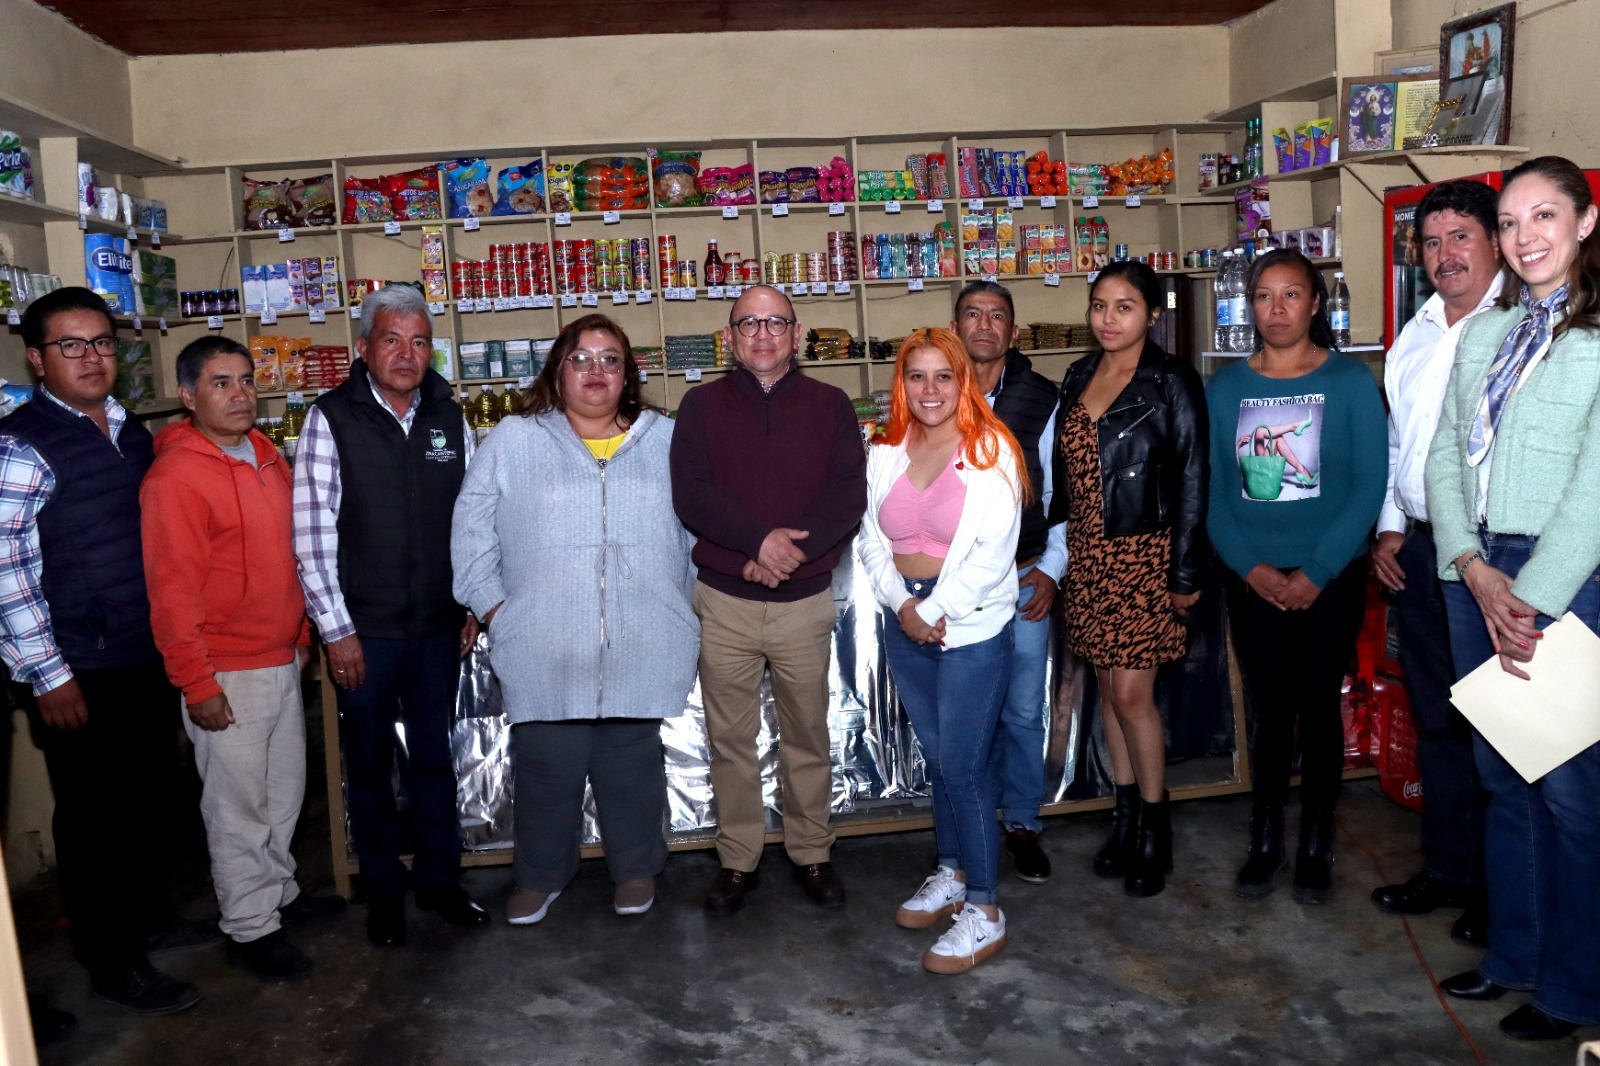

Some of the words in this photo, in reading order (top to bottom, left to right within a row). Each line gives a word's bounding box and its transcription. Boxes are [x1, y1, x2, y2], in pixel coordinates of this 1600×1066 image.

[1241, 399, 1271, 408] BEAUTY
[1272, 397, 1306, 406] FASHION
[1308, 395, 1324, 404] BAG
